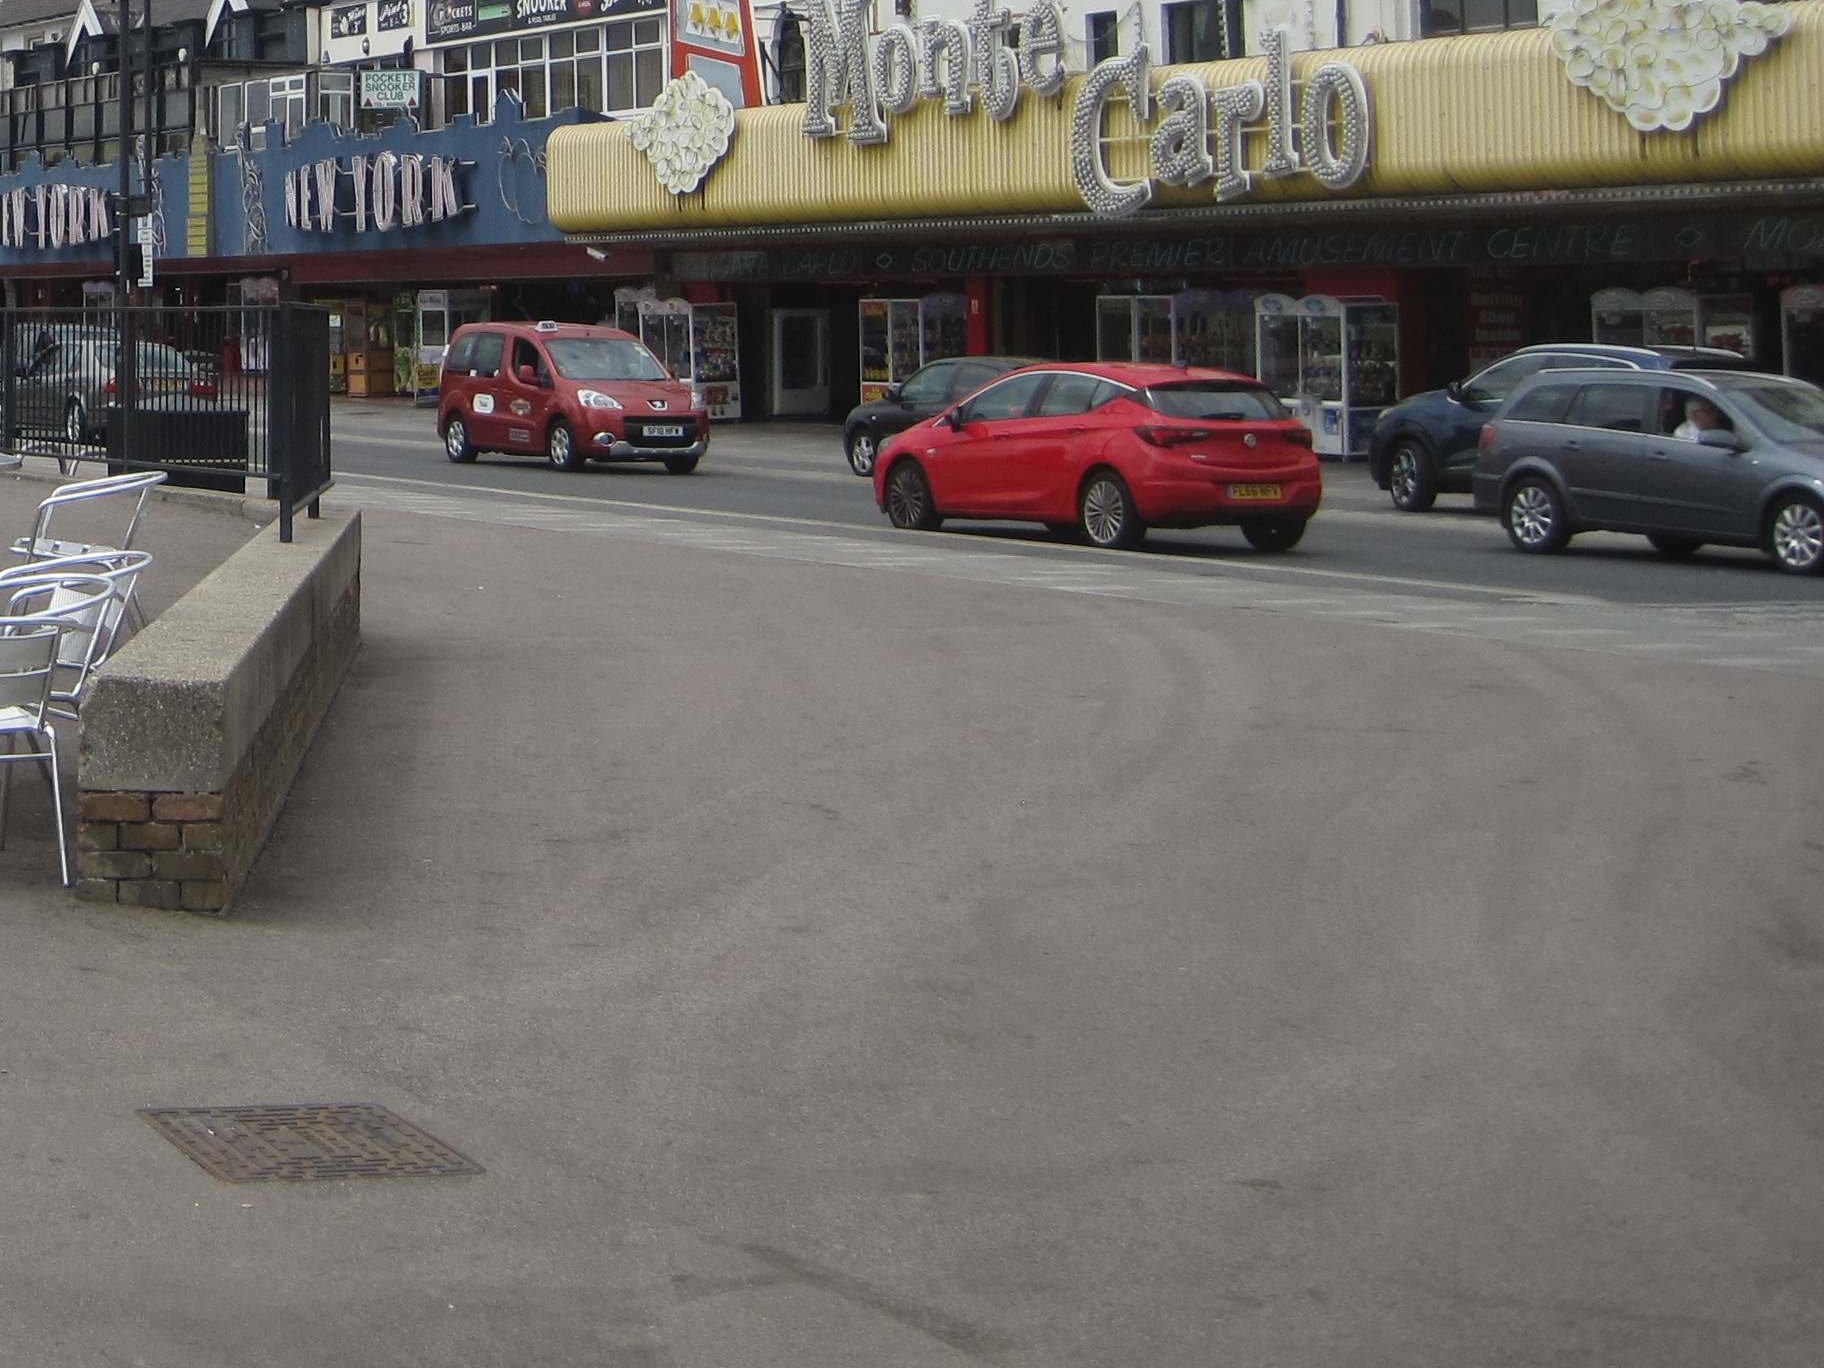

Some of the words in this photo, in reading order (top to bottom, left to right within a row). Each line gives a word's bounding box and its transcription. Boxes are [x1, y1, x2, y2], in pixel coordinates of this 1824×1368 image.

[365, 73, 415, 82] POCKETS
[366, 82, 415, 92] SNOOKER
[377, 92, 404, 101] CLUB
[1071, 28, 1369, 218] Carlo
[36, 183, 108, 250] YORK
[284, 157, 336, 232] NEW
[352, 151, 457, 232] YORK
[912, 242, 1071, 273] SOUTHENDS
[1091, 236, 1228, 268] PREMIER
[1245, 230, 1464, 264] AMUSEMENT
[1487, 223, 1636, 259] CENTRE
